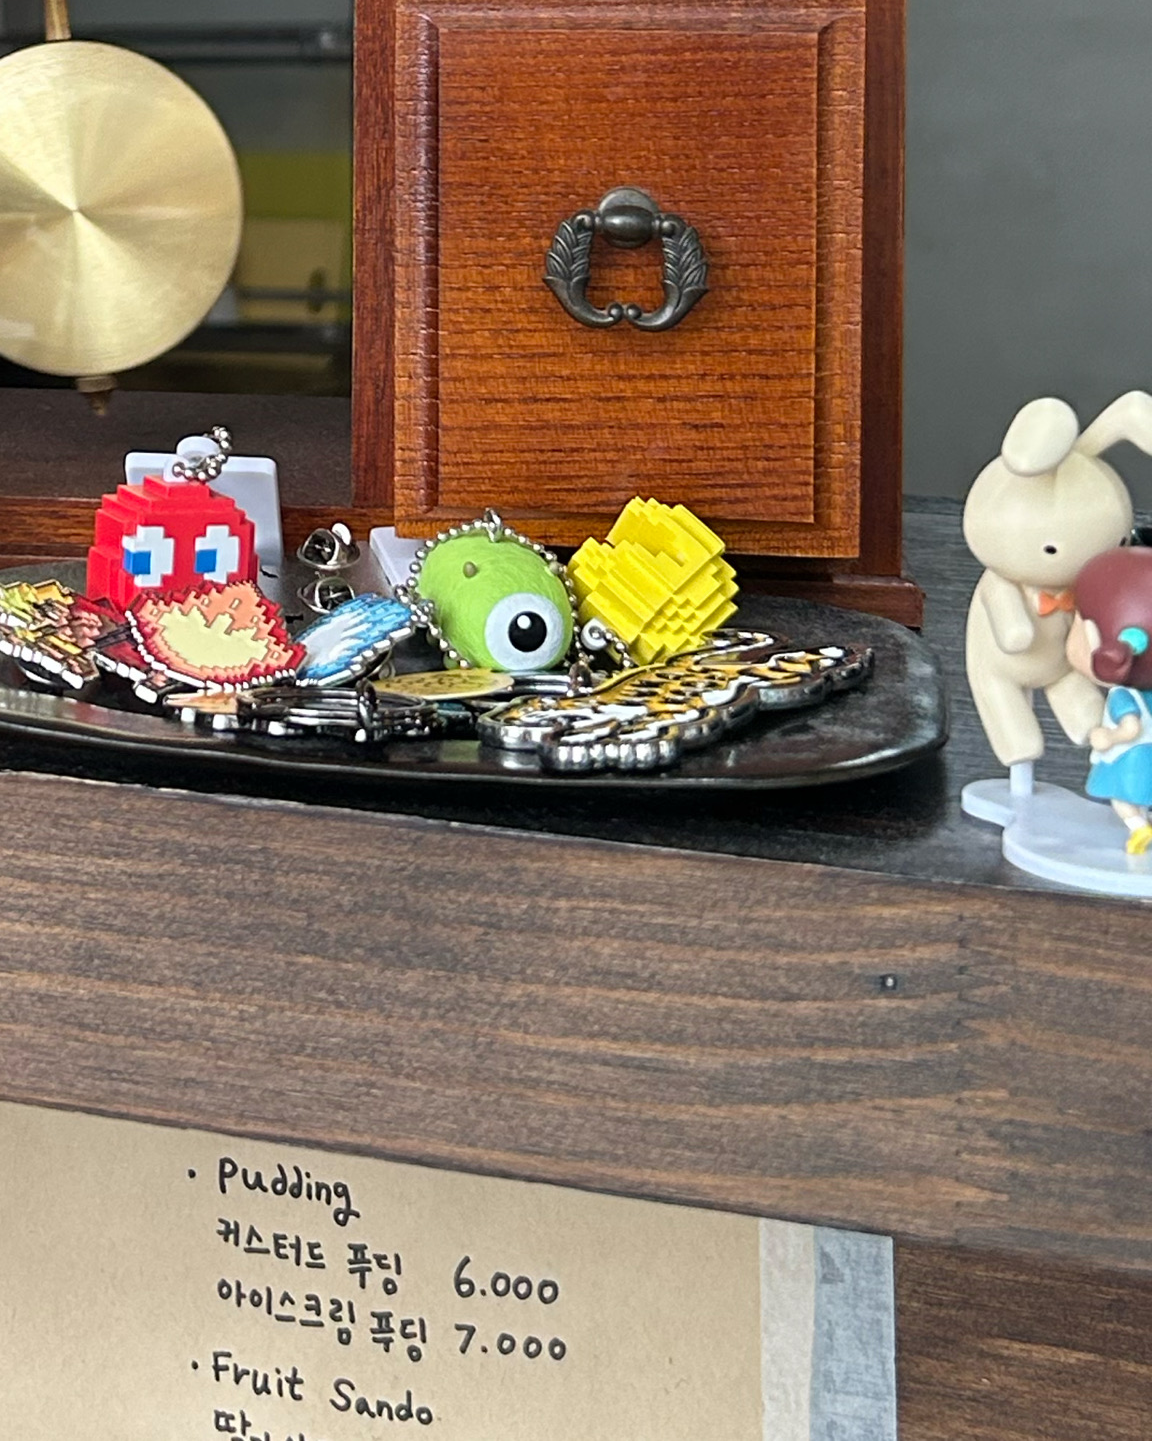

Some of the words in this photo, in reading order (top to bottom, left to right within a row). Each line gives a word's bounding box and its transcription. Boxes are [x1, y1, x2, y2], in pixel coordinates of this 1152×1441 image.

[219, 1157, 361, 1227] Pudding
[216, 1218, 326, 1269] 커스터드
[347, 1243, 402, 1296] 푸딩
[453, 1255, 559, 1304] 6.000
[217, 1278, 356, 1346] 아이스크림
[370, 1310, 428, 1363] 푸딩
[454, 1323, 567, 1361] 7.000
[212, 1351, 305, 1401] Fruit
[329, 1378, 433, 1425] Sando
